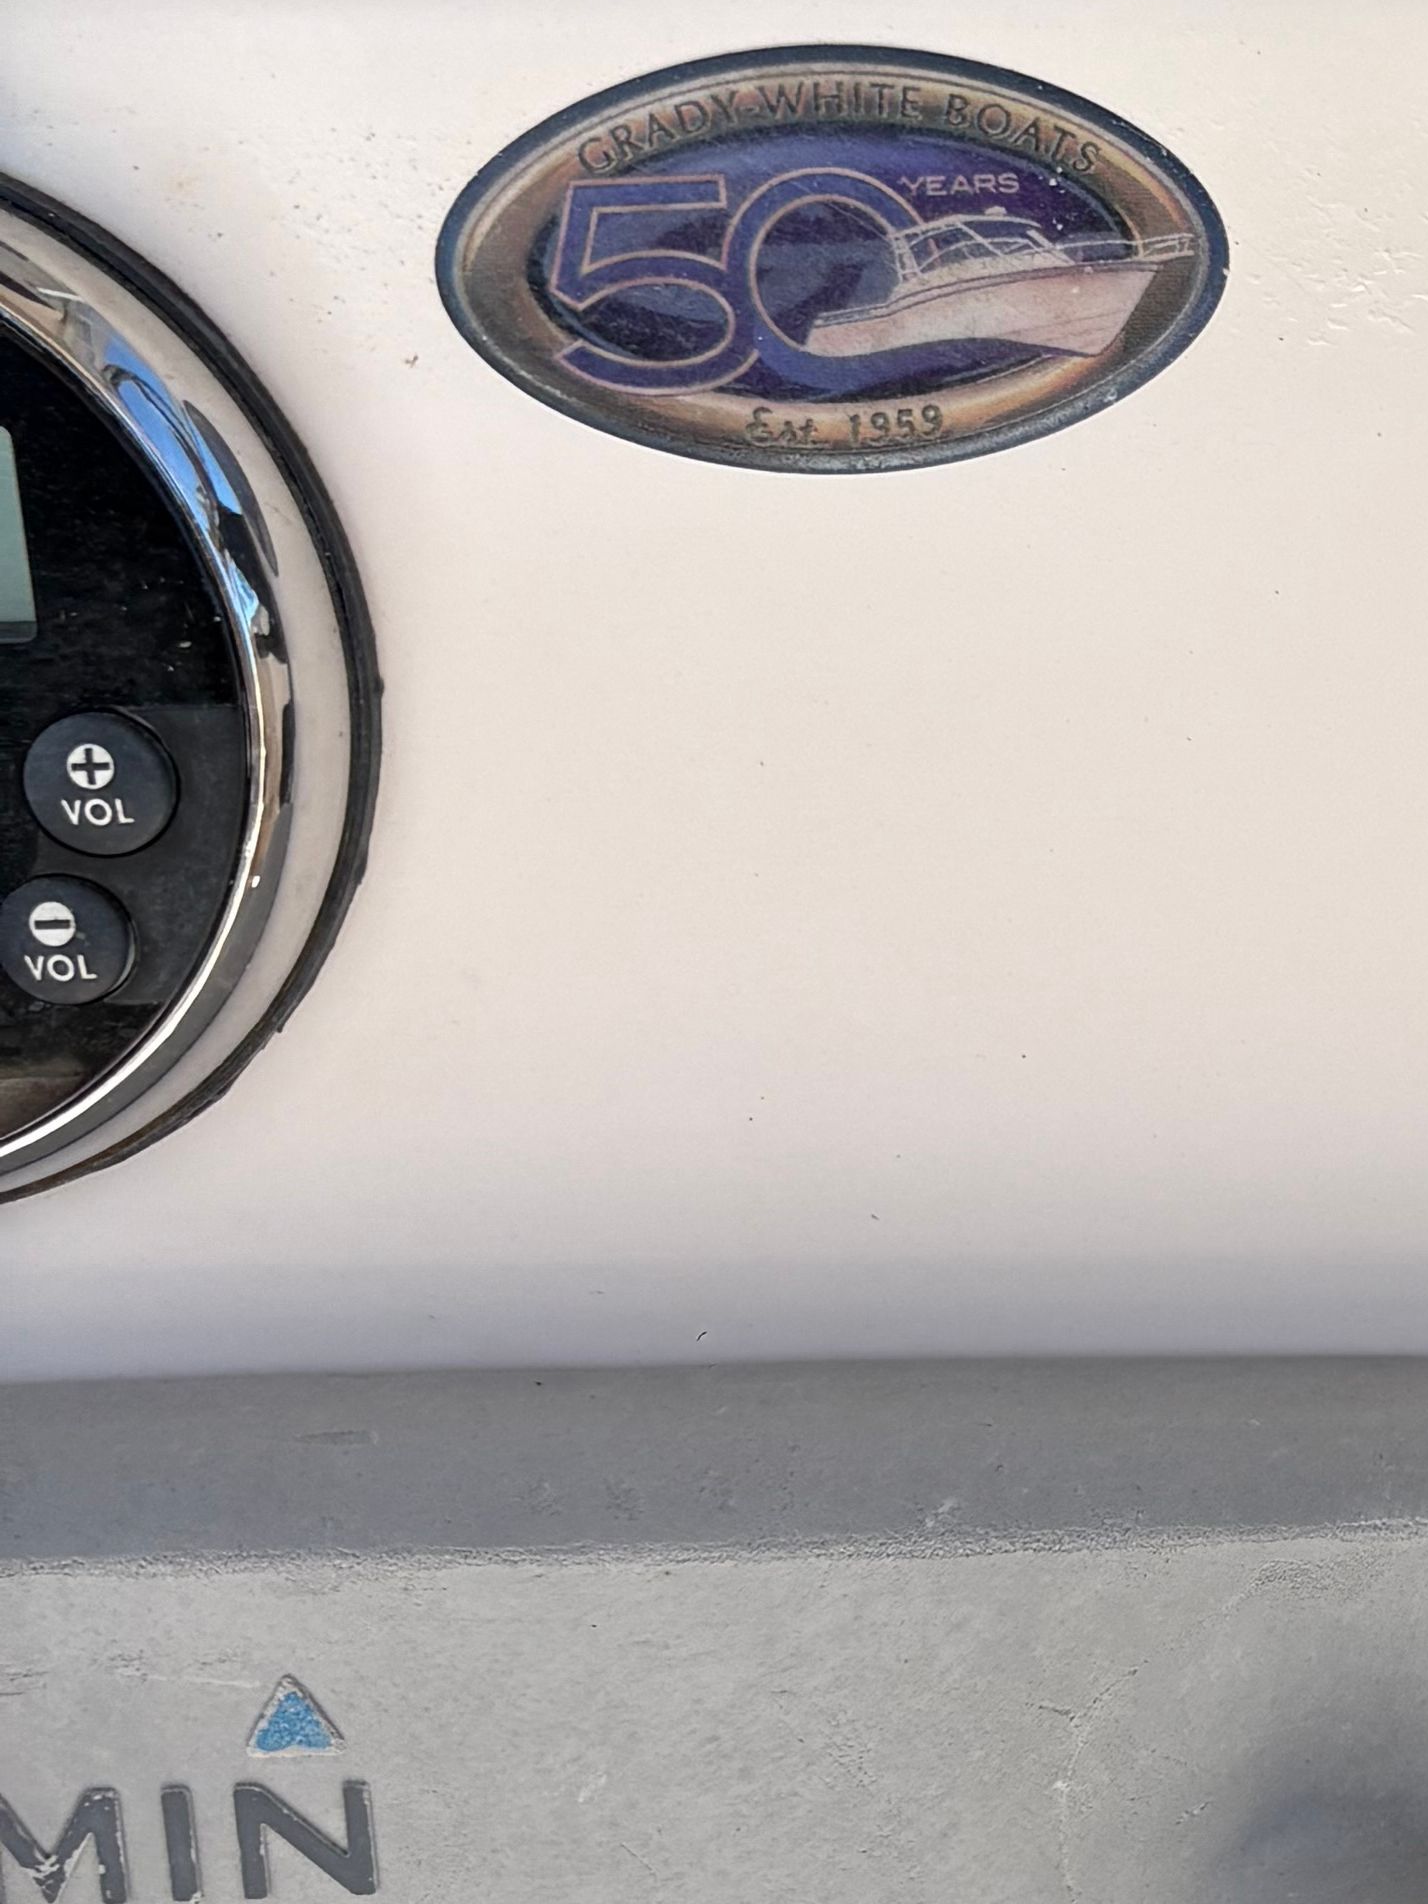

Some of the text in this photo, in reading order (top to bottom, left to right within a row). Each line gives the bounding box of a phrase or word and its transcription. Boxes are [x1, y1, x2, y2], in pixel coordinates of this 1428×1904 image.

[577, 81, 1101, 175] GRADY-WHITE BOATS
[899, 172, 1020, 196] YEARS
[547, 165, 925, 403] 50
[849, 403, 944, 445] 1959
[60, 798, 135, 826] VOL
[24, 954, 97, 982] VOL
